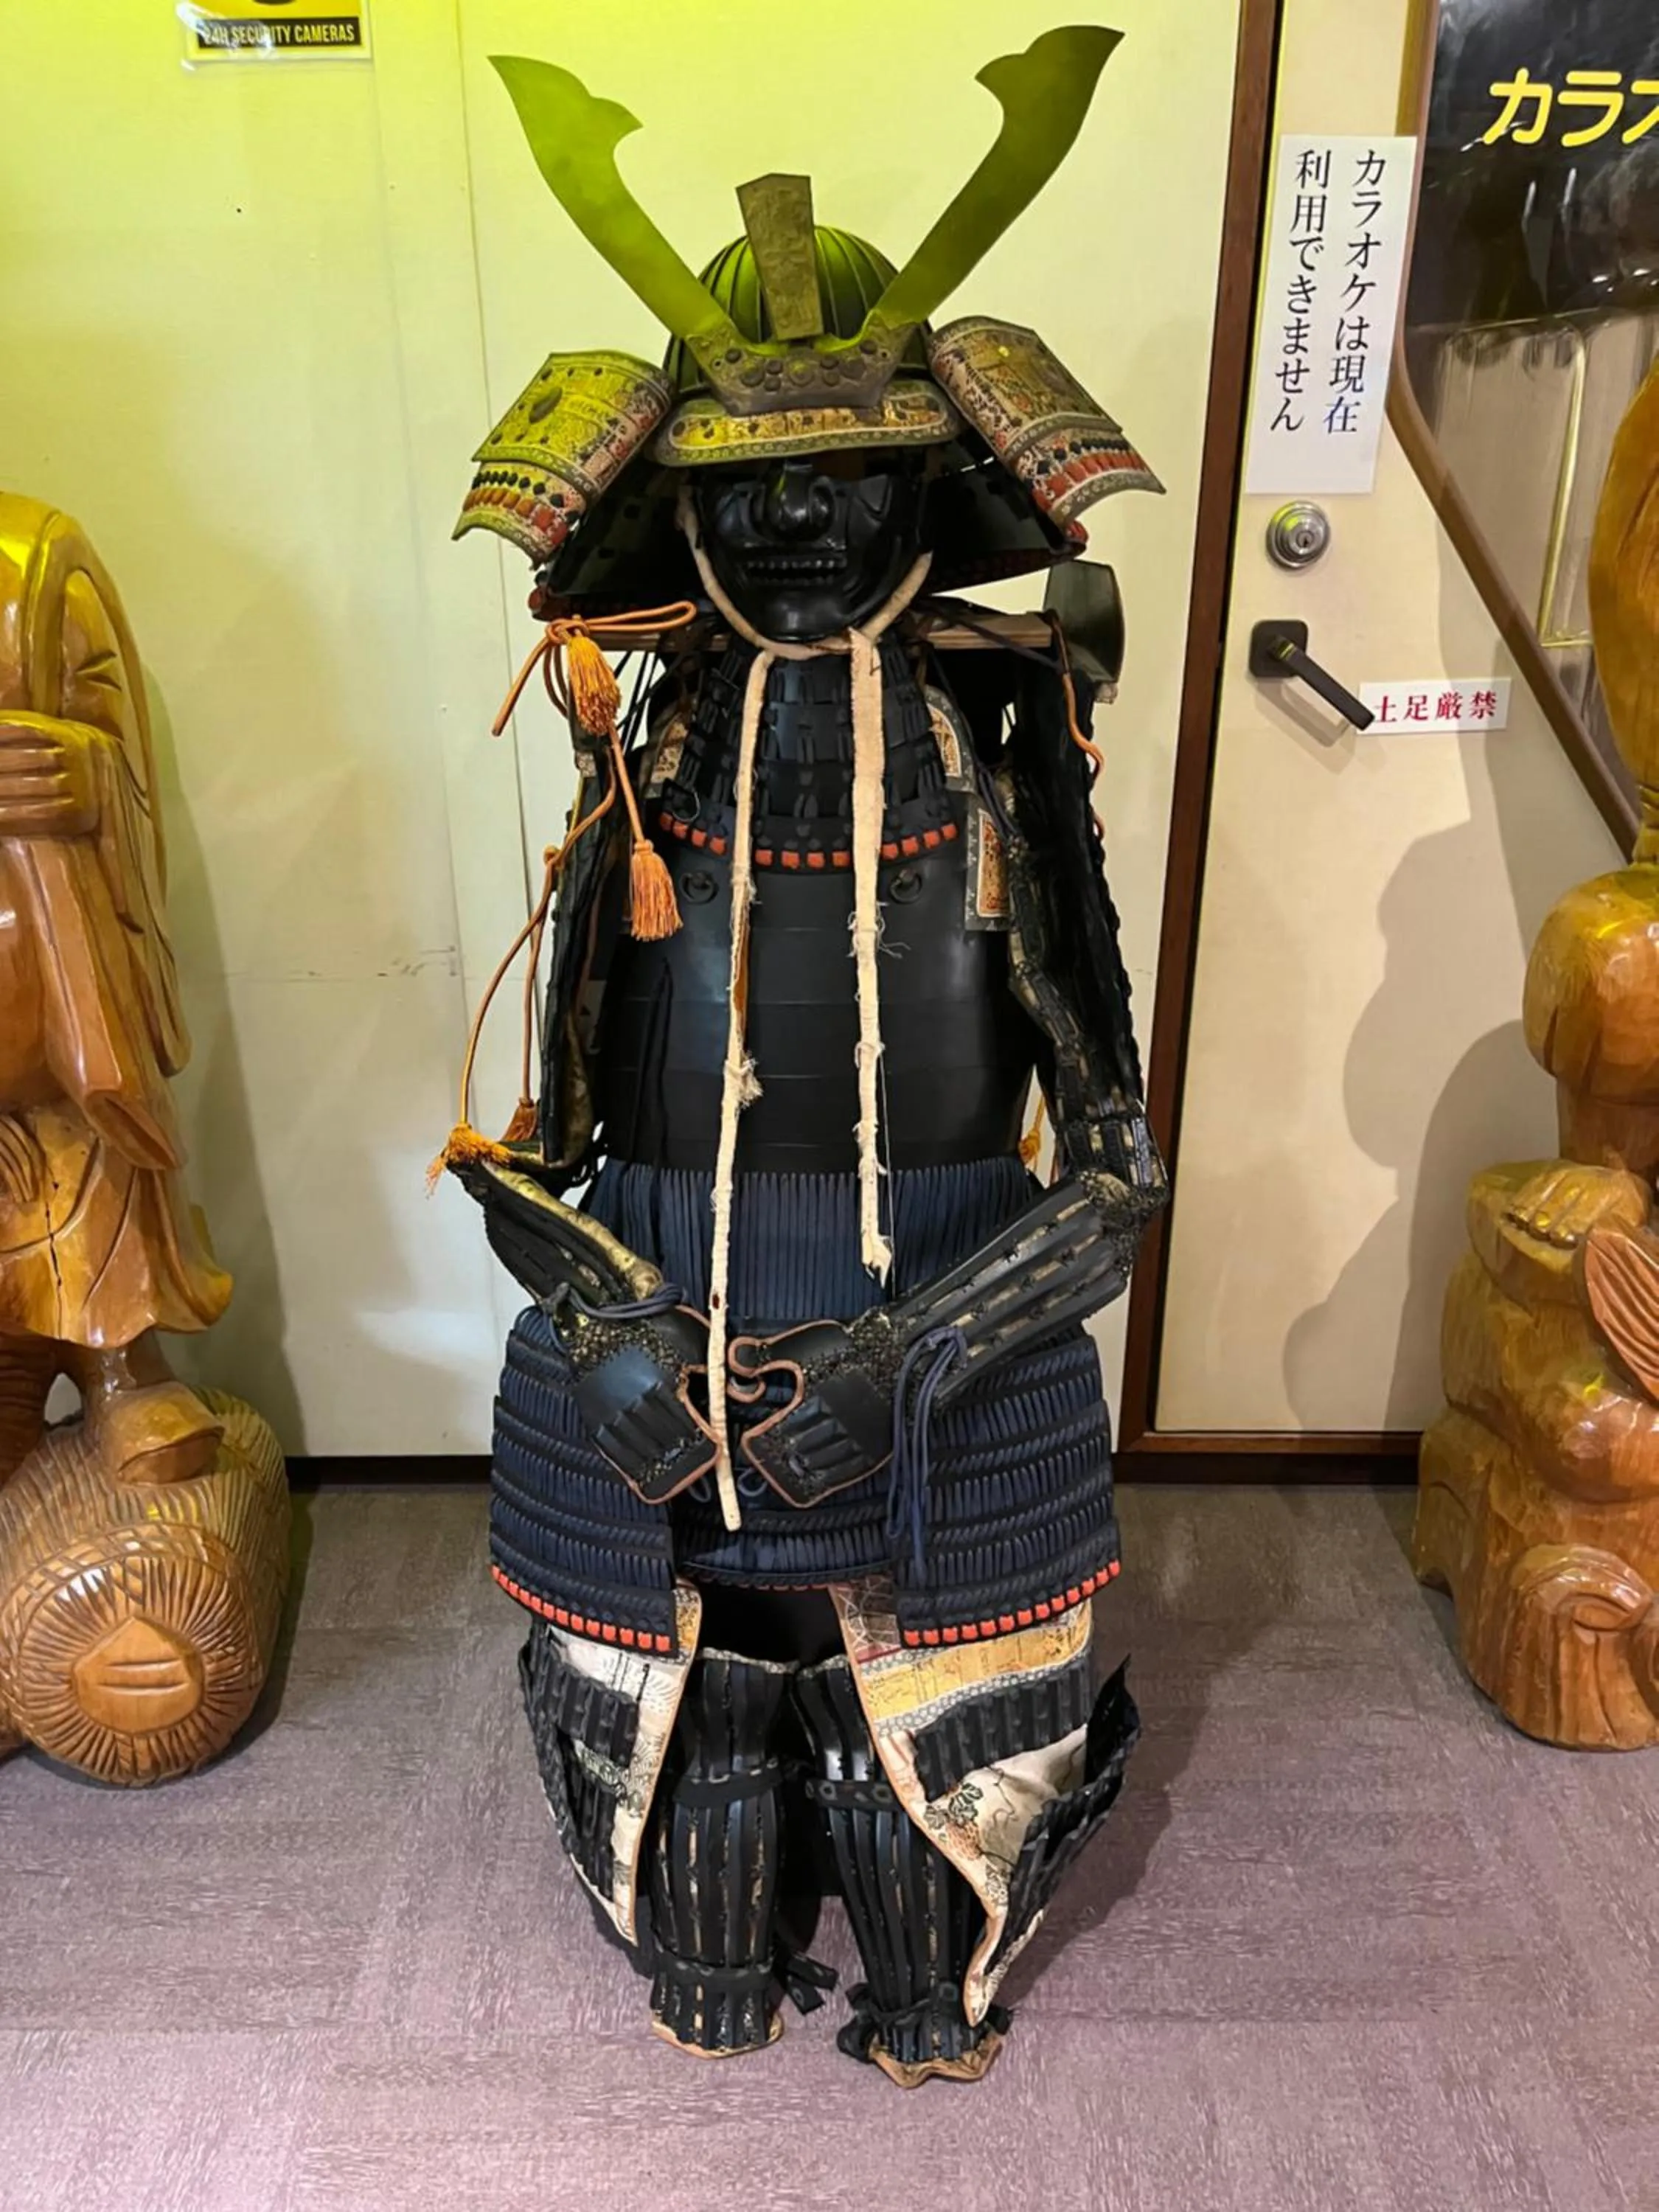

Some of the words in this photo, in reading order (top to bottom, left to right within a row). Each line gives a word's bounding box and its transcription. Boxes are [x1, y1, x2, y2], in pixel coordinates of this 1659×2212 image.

[232, 24, 291, 44] SECURITY
[295, 24, 355, 43] CAMERAS
[1270, 149, 1332, 433] 利用できません
[1323, 149, 1386, 434] カラオケは現在
[1374, 690, 1498, 722] 土足厳禁
